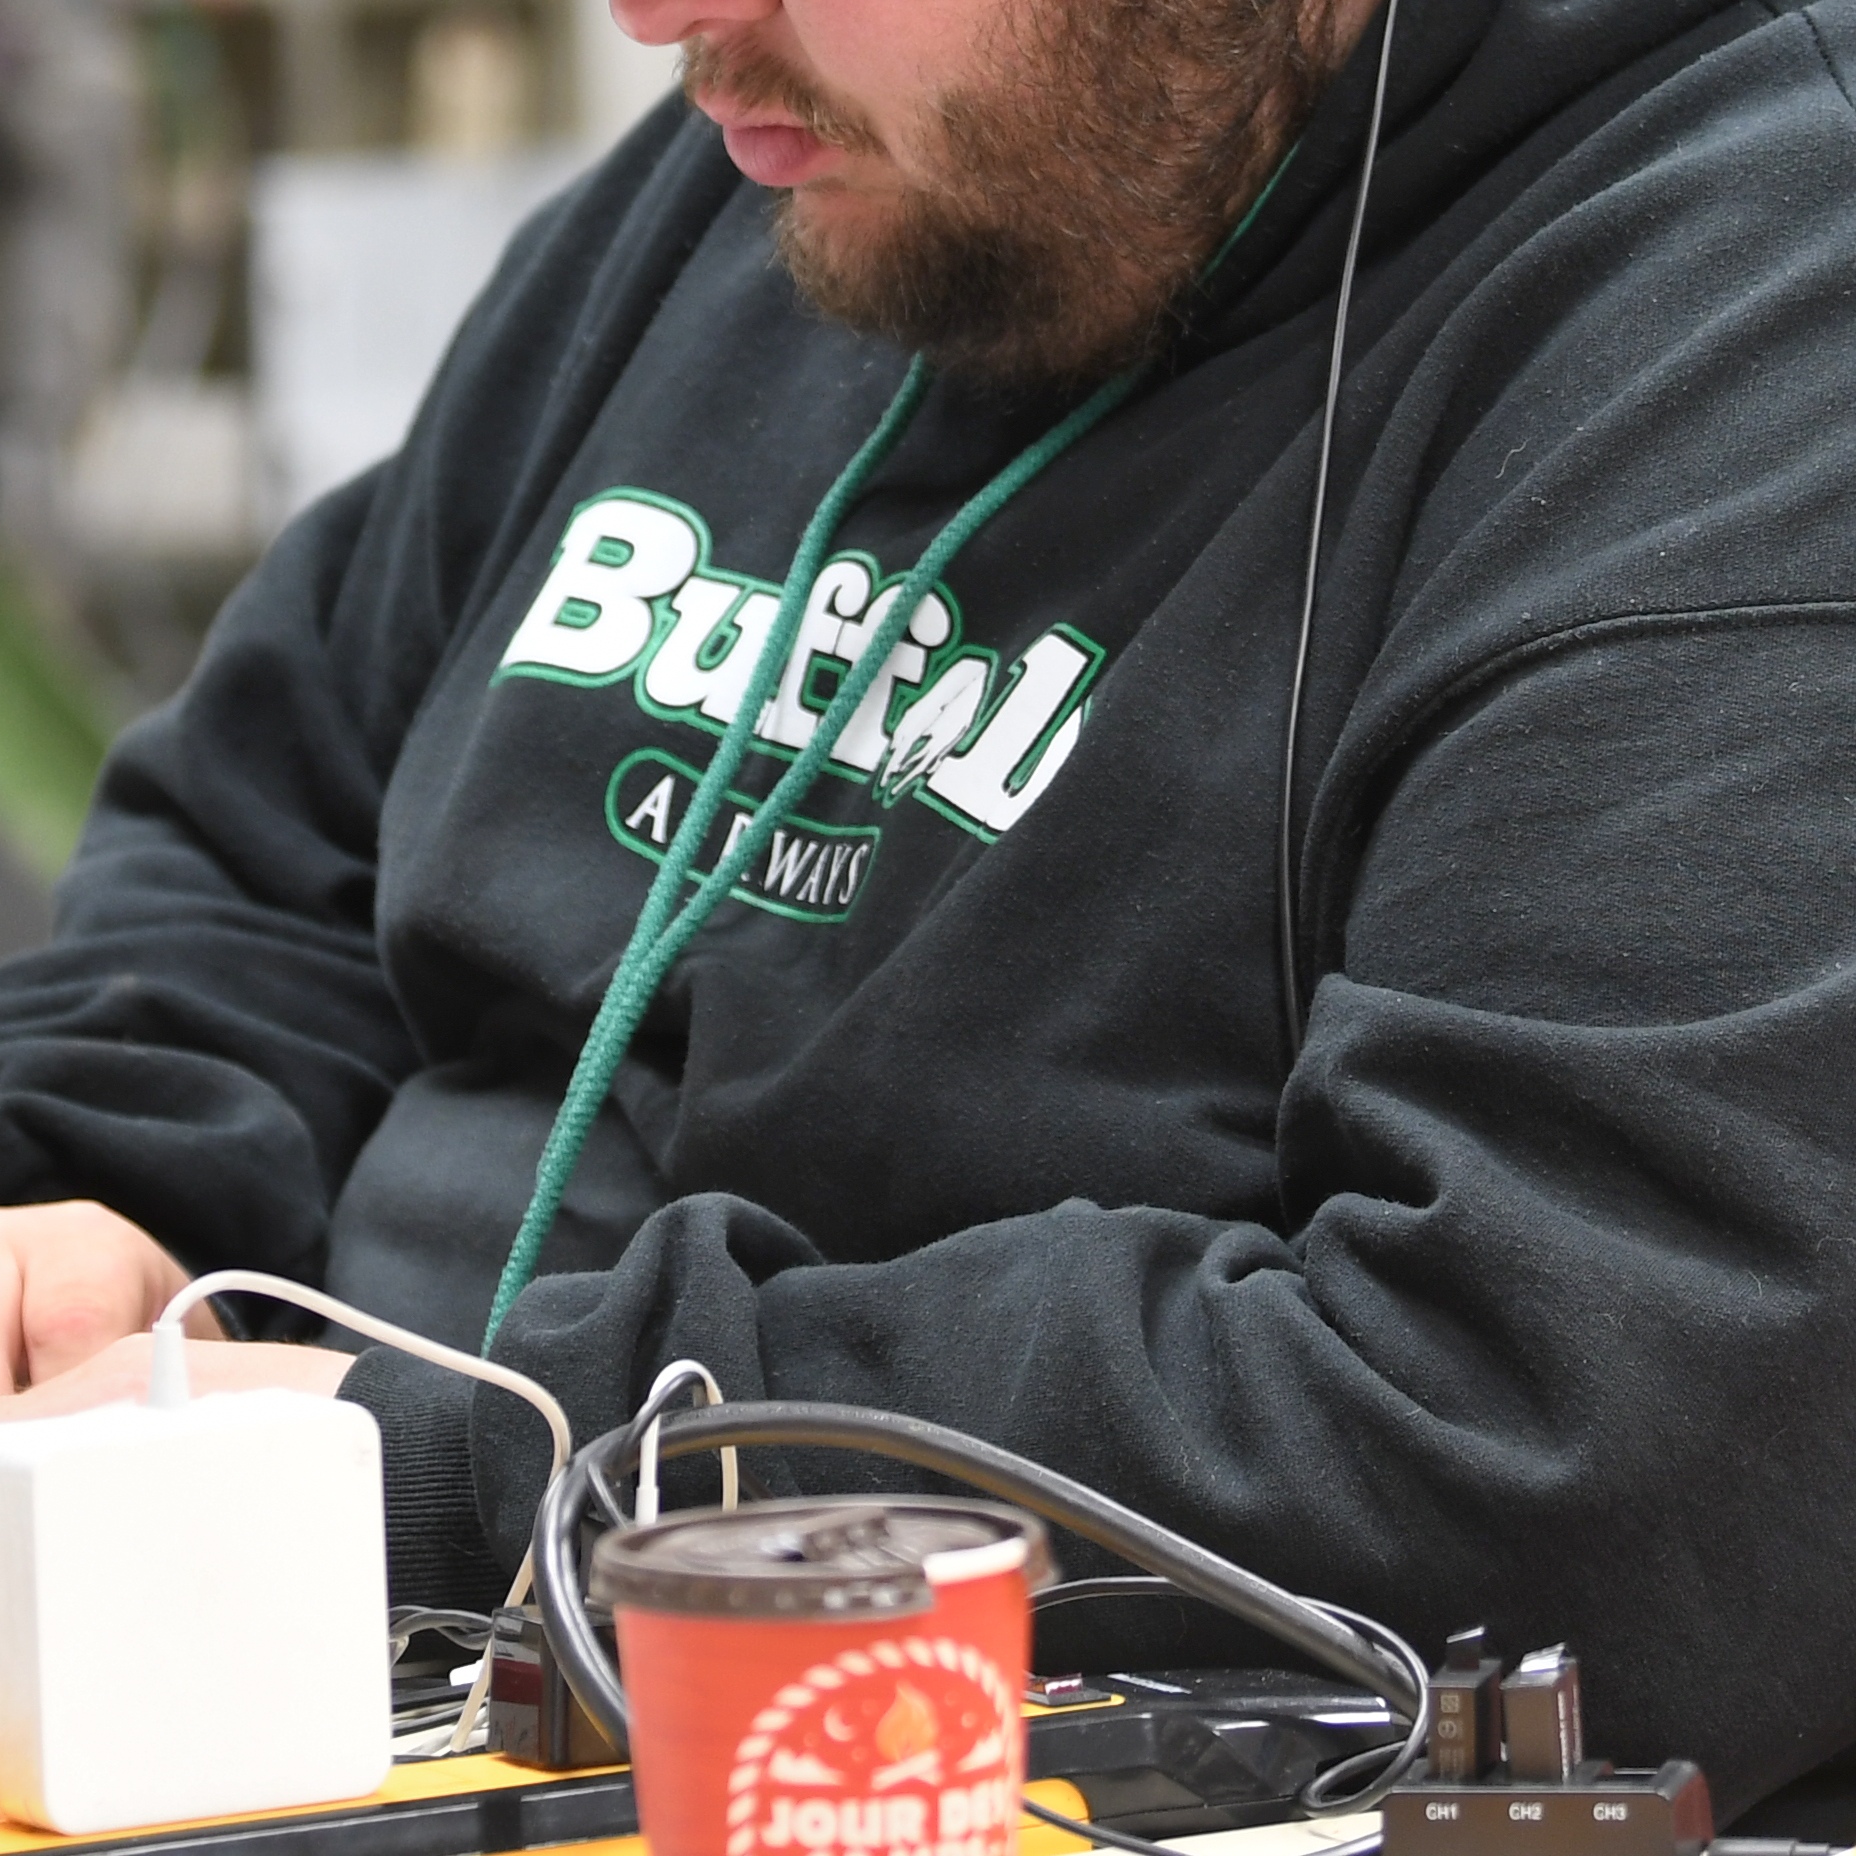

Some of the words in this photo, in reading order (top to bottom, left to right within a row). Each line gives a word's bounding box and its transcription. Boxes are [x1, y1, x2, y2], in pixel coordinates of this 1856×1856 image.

[626, 773, 868, 905] AWAYS
[1425, 1802, 1458, 1820] CH1
[1508, 1802, 1542, 1820] CH2
[1593, 1802, 1628, 1820] CH3
[762, 1797, 928, 1848] JOUR
